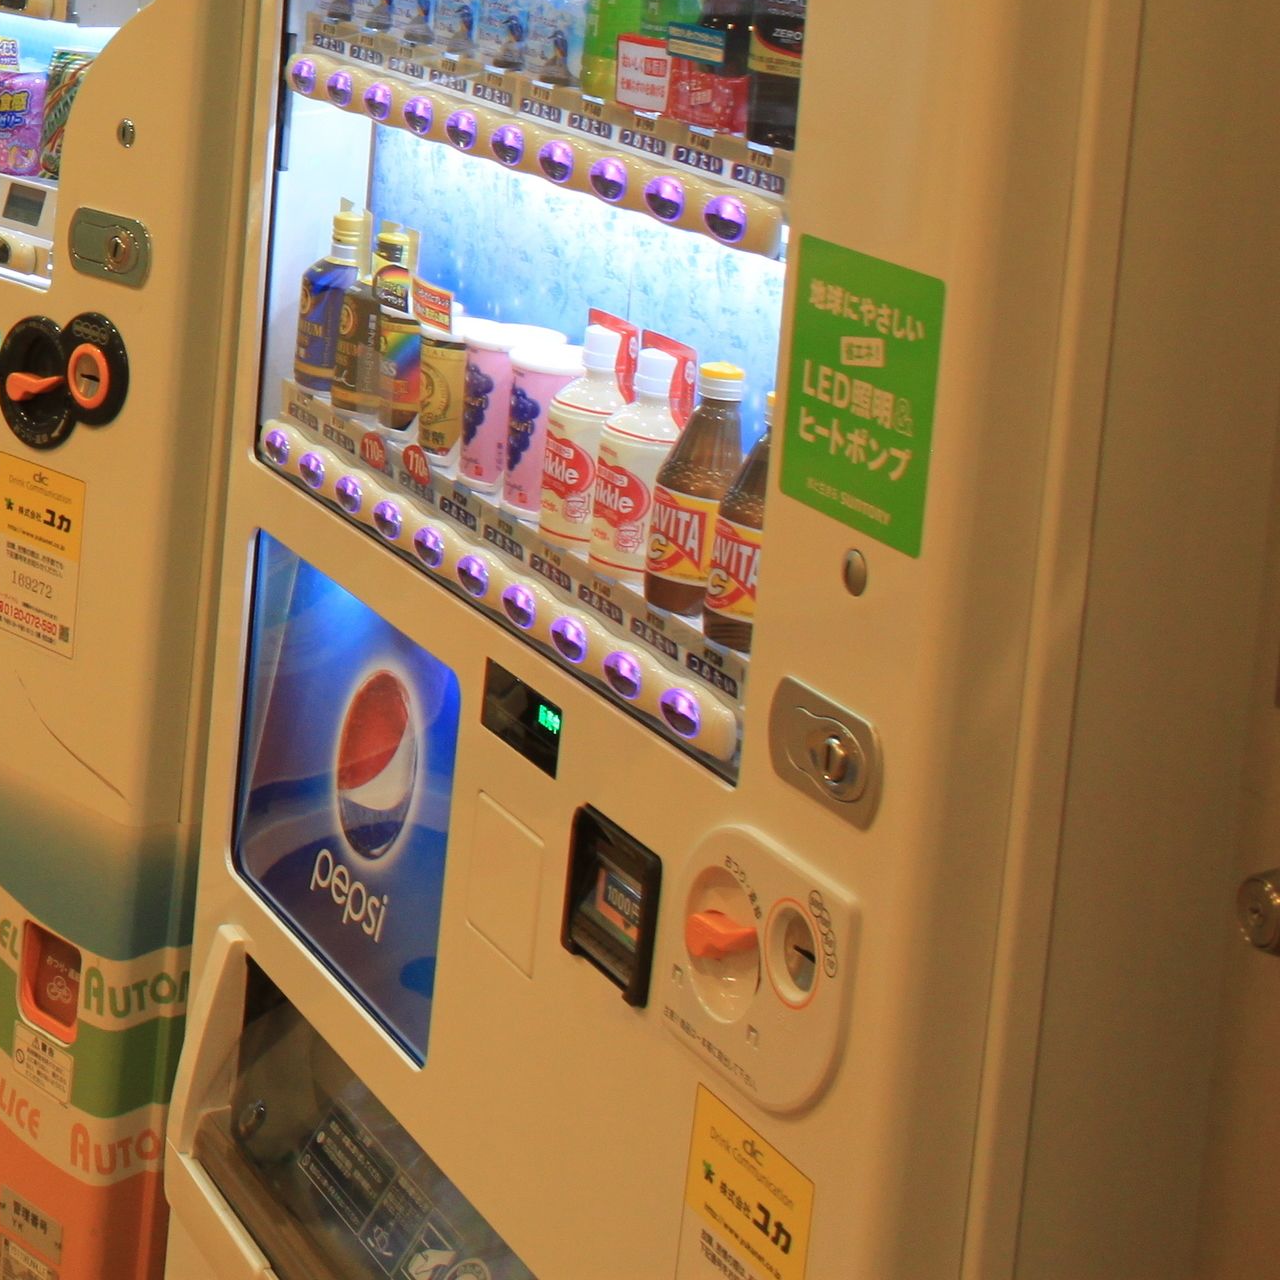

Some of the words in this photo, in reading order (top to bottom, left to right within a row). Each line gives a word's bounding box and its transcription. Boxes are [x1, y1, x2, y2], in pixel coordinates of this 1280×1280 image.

[773, 28, 803, 40] ZERO
[474, 84, 512, 107] つめたい
[522, 99, 561, 124] つめたい
[570, 114, 612, 140] つめたい
[621, 129, 666, 158] つめたい
[675, 145, 723, 176] つめたい
[733, 164, 785, 194] つめたい
[809, 278, 925, 341] 地球にやさしい
[799, 406, 912, 481] ヒートポンプ
[18, 504, 72, 534] 株式会社ユカ
[441, 496, 477, 530] つめたい
[485, 525, 522, 560] つめたい
[646, 533, 668, 561] C
[11, 570, 52, 599] 169272
[530, 553, 571, 591] つめたい
[708, 567, 729, 594] C
[578, 583, 623, 624] つめたい
[631, 617, 678, 660] つめたい
[687, 651, 738, 697] つめたい
[310, 848, 389, 943] pepsi
[731, 1147, 794, 1211] Communication
[13, 1200, 48, 1235] 管理番号
[719, 1181, 793, 1255] 株式会社ユカ
